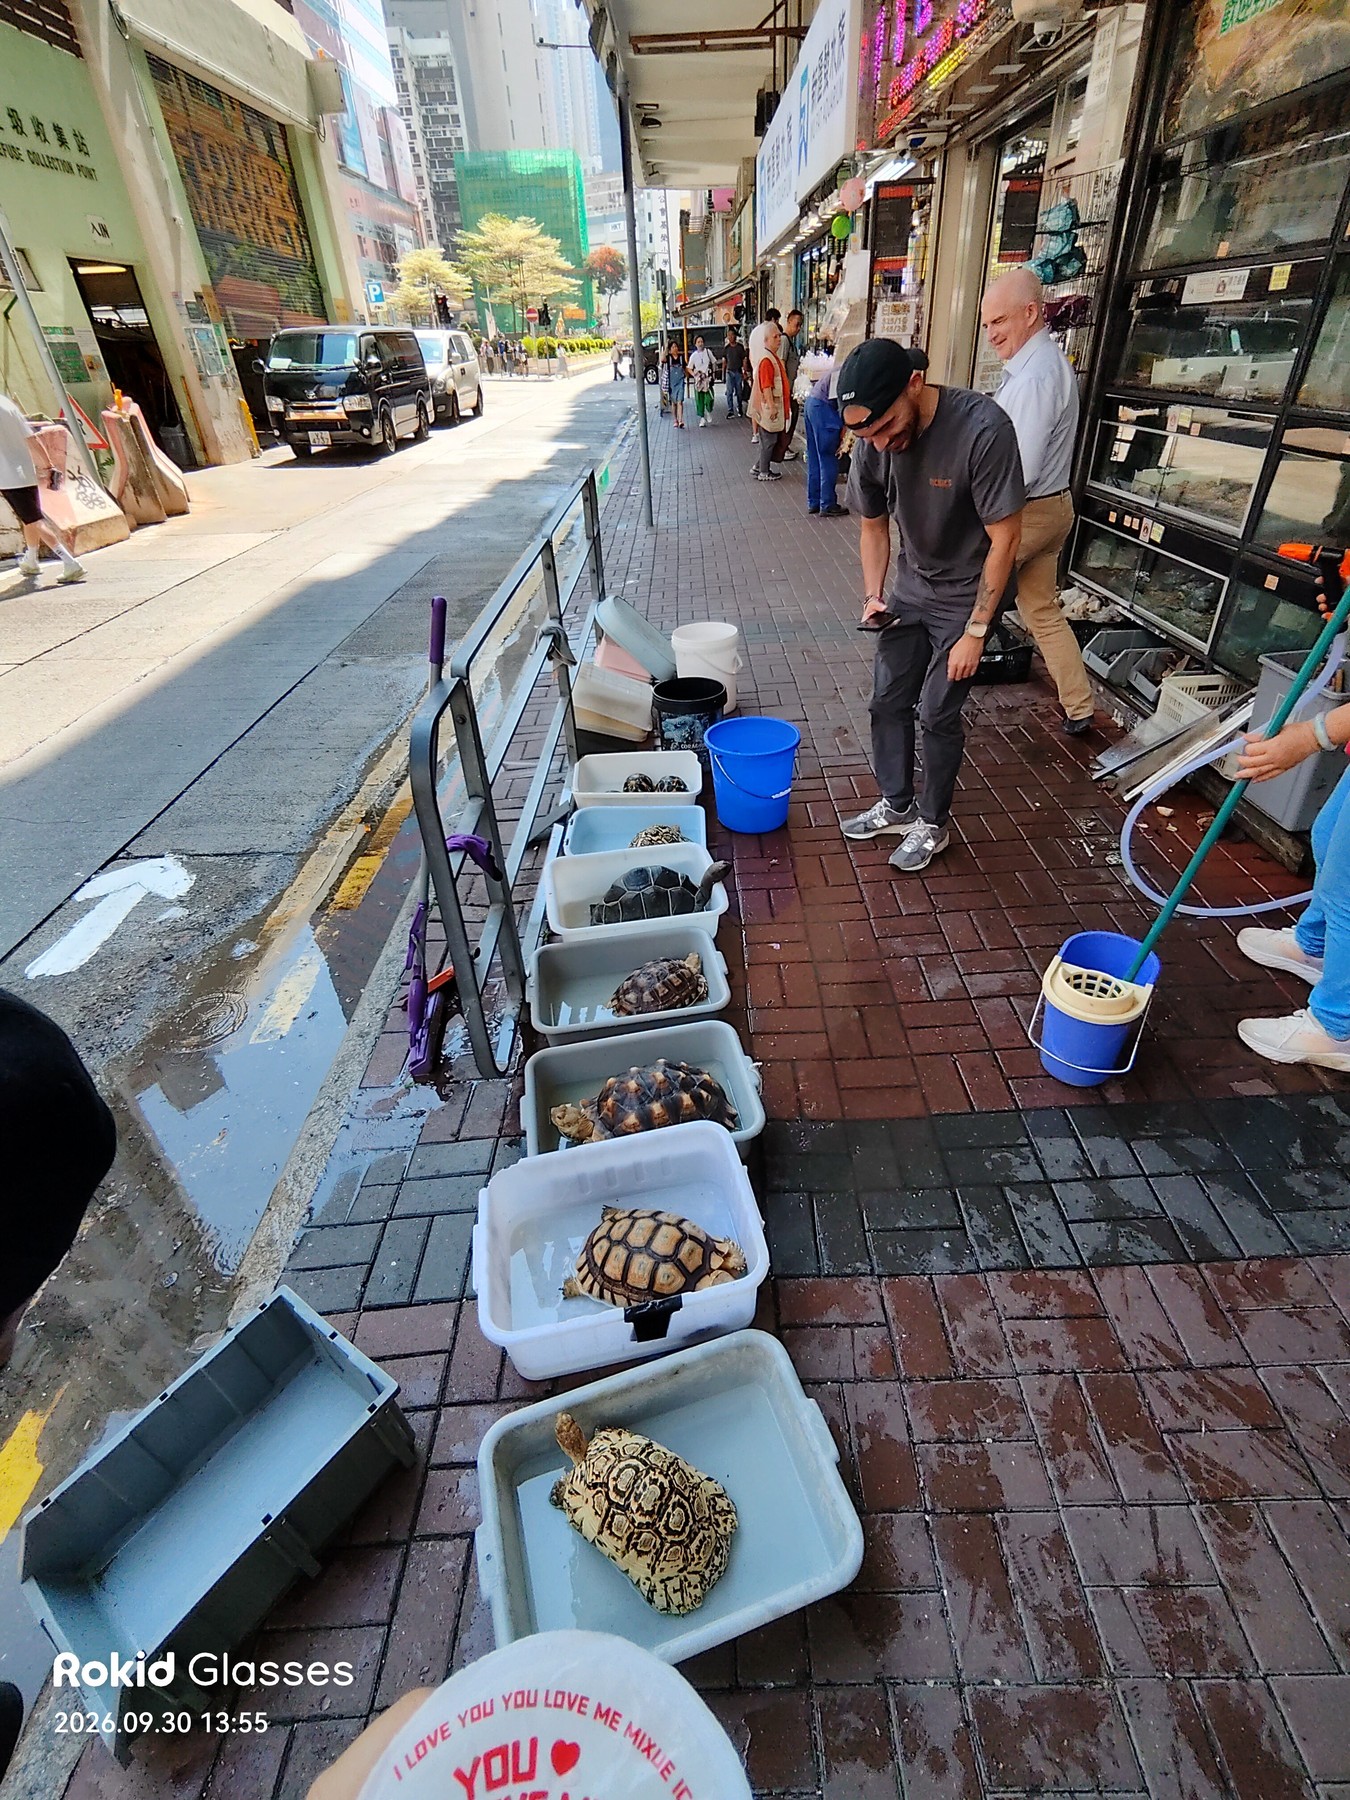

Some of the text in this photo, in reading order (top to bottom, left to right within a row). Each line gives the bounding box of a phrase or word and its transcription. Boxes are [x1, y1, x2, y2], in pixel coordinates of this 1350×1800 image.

[0, 106, 90, 158] 圾收集站
[27, 149, 75, 176] COLLECTION
[76, 163, 98, 181] POINT
[368, 284, 381, 302] P
[394, 1765, 402, 1781] I
[404, 1721, 452, 1770] LOVE
[457, 1698, 494, 1728] YOU
[501, 1689, 538, 1711] YOU
[543, 1689, 590, 1716] LOVE
[593, 1701, 623, 1732] ME
[623, 1721, 676, 1782] MIXUE
[453, 1736, 538, 1800] YOU
